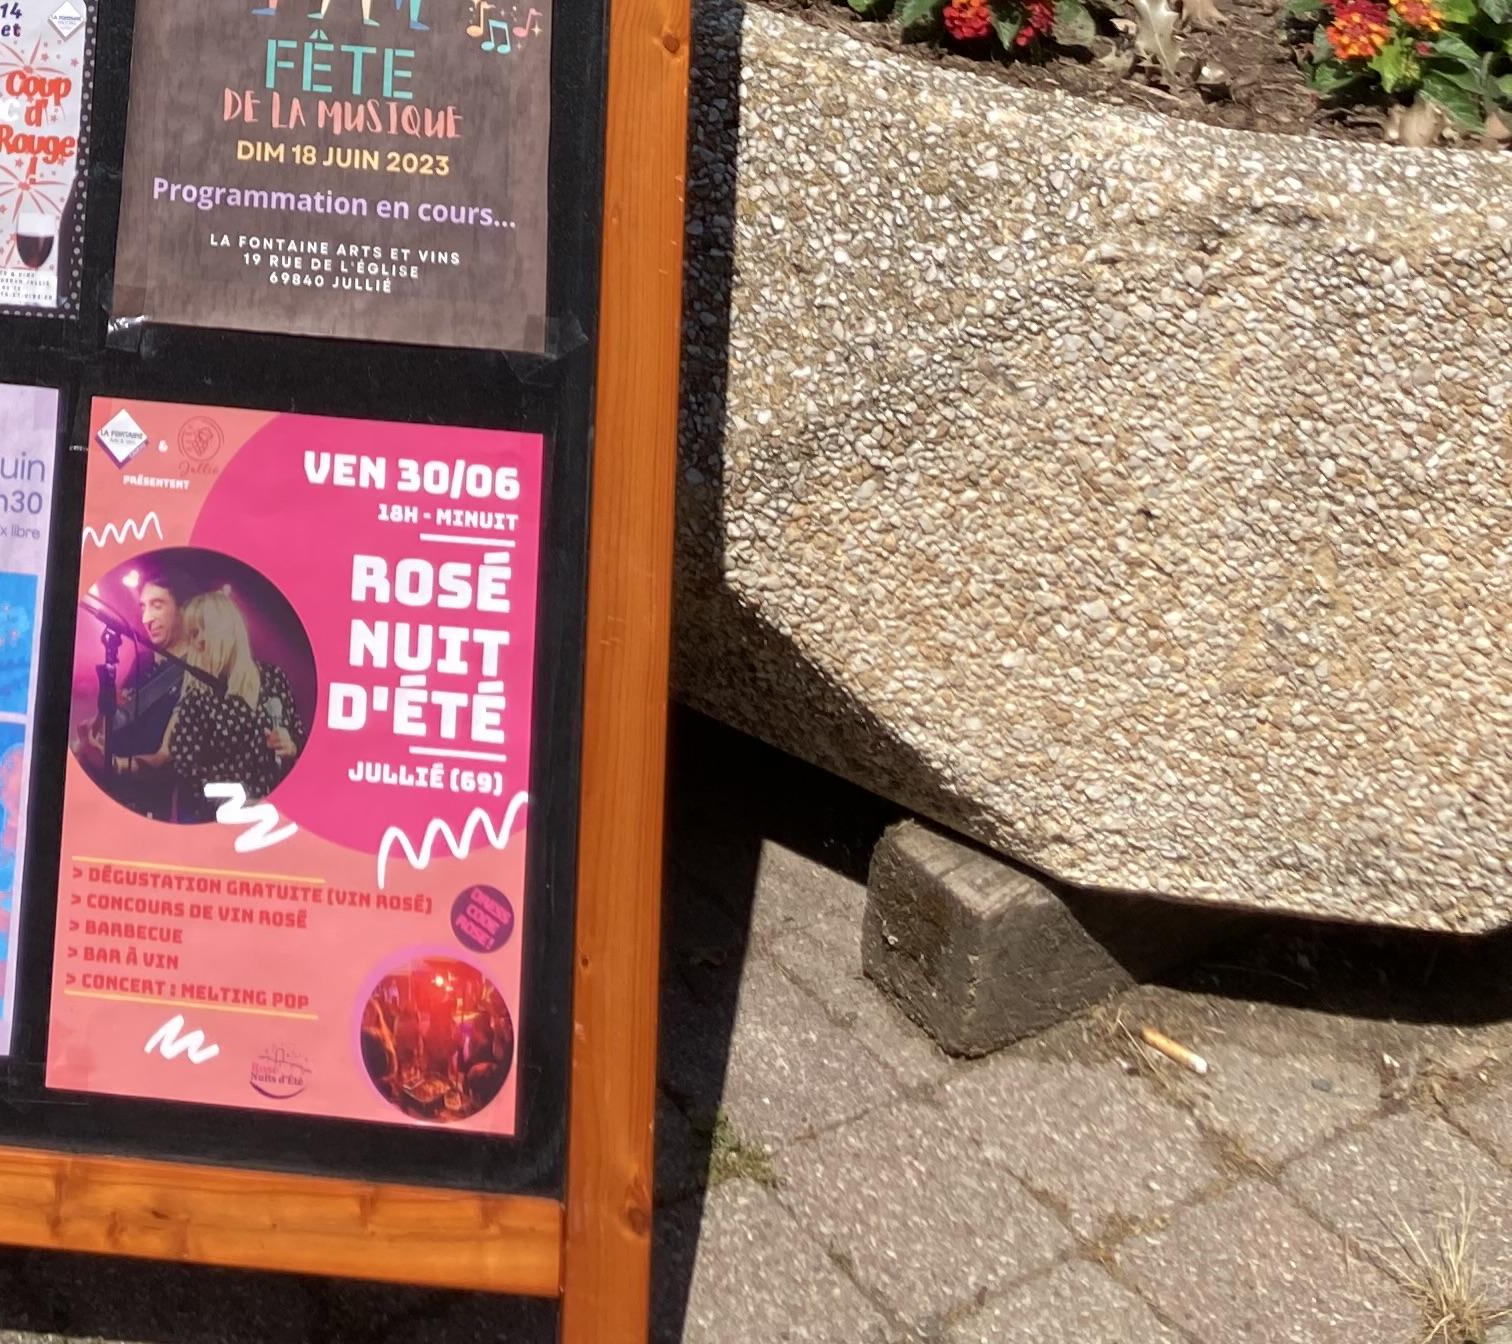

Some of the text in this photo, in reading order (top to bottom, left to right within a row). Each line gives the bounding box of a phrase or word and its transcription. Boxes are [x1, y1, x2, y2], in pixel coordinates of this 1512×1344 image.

[0, 1, 23, 19] 14
[265, 29, 415, 100] FÊTE
[6, 70, 72, 106] Coup
[223, 88, 464, 139] DE LA MUSIQUE
[237, 140, 450, 176] DIM 18 JUIN 2023
[153, 177, 516, 228] Programmation en cours...
[210, 233, 460, 266] LA FONTAINE ARTS ET VINS
[243, 252, 419, 279] 19 RUE DE L'ÉGLISE
[269, 271, 391, 293] 69840 JULLIÉ
[123, 474, 190, 490] PRÉSENTENT
[304, 450, 521, 500] VEN 30/06
[10, 522, 41, 539] libre
[378, 503, 418, 523] 18H
[436, 508, 519, 531] MINUIT
[351, 551, 511, 613] ROSÉ
[349, 618, 510, 677] NUIT
[327, 674, 506, 744] D'ÉTÉ
[348, 761, 503, 797] JULLIÉ (69)
[88, 865, 432, 915] DÉGUSTATION GRATUITE (VIN ROSÉ)
[86, 893, 308, 929] CONCOURS DE VIN ROSÉ
[85, 919, 183, 944] BARBECUE
[83, 946, 179, 970] BAR À VIN
[81, 972, 166, 996] CONCERT
[181, 984, 267, 1008] MELTING
[272, 992, 309, 1010] POP
